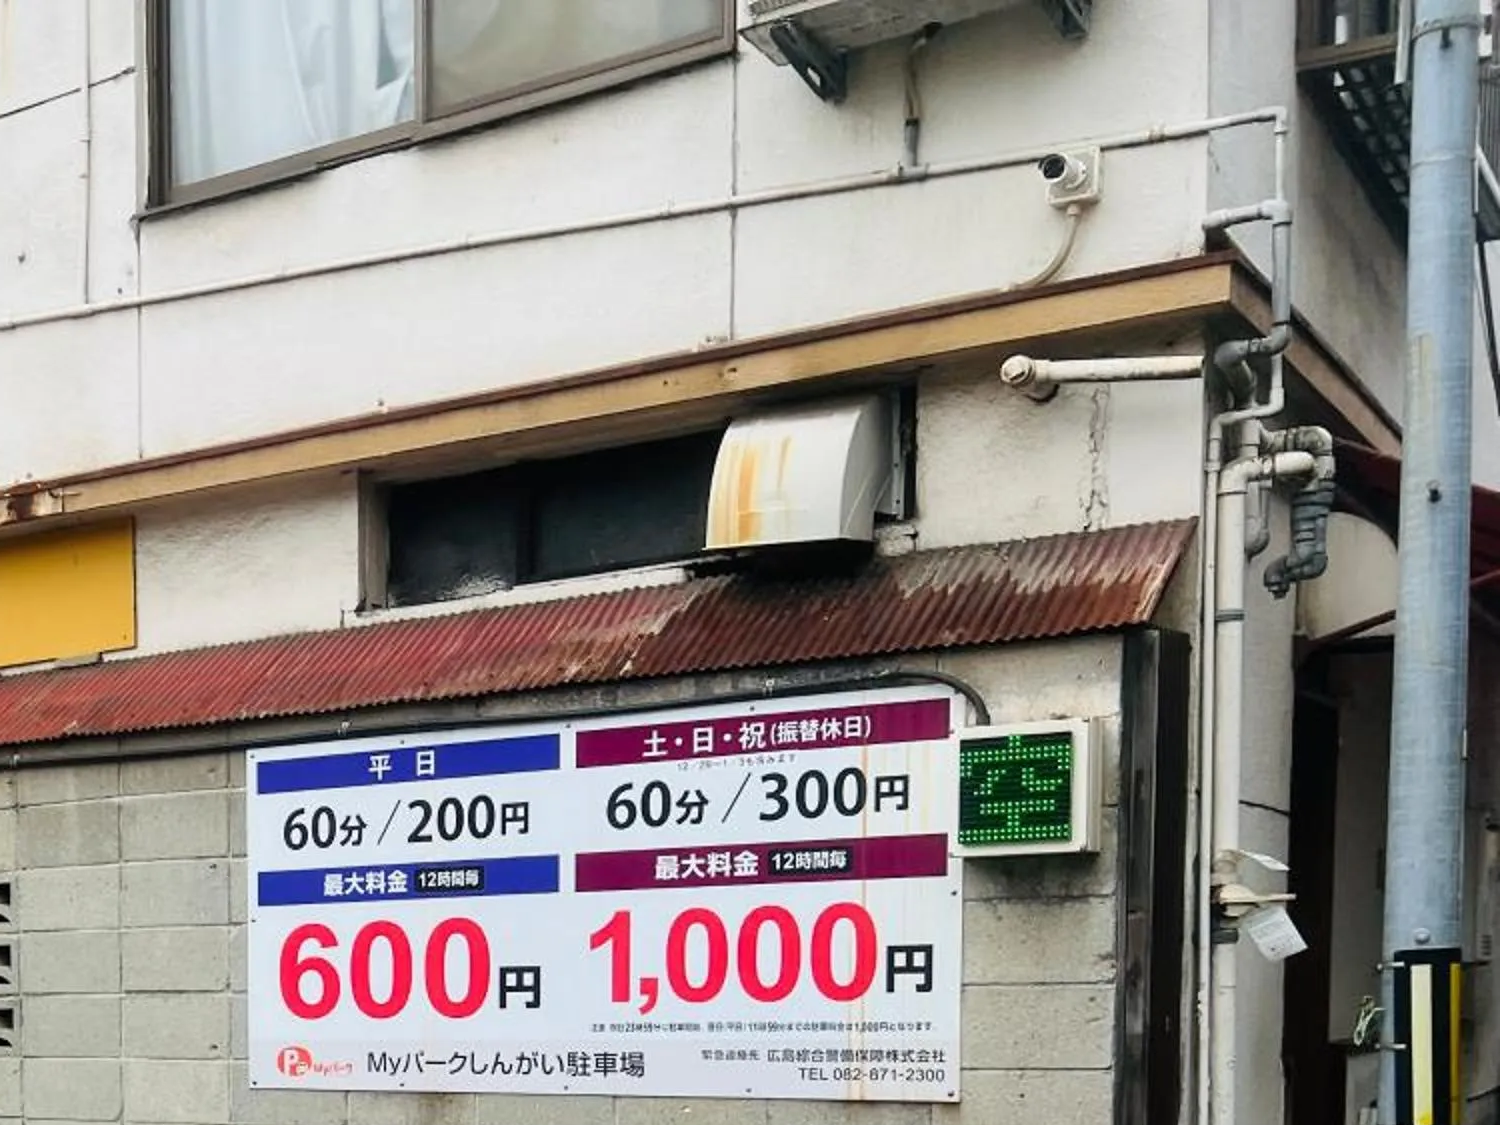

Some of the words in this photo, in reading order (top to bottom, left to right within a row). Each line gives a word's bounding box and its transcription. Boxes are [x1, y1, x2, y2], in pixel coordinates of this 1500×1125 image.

[368, 750, 436, 781] 平日
[959, 735, 1071, 842] 空
[655, 851, 759, 880] 最大料金
[323, 870, 408, 896] 最大料金
[279, 917, 541, 1019] 600円
[589, 902, 934, 1015] 1,000円
[366, 1050, 645, 1078] Myパークしんがい駐車場
[799, 1067, 829, 1081] TEL
